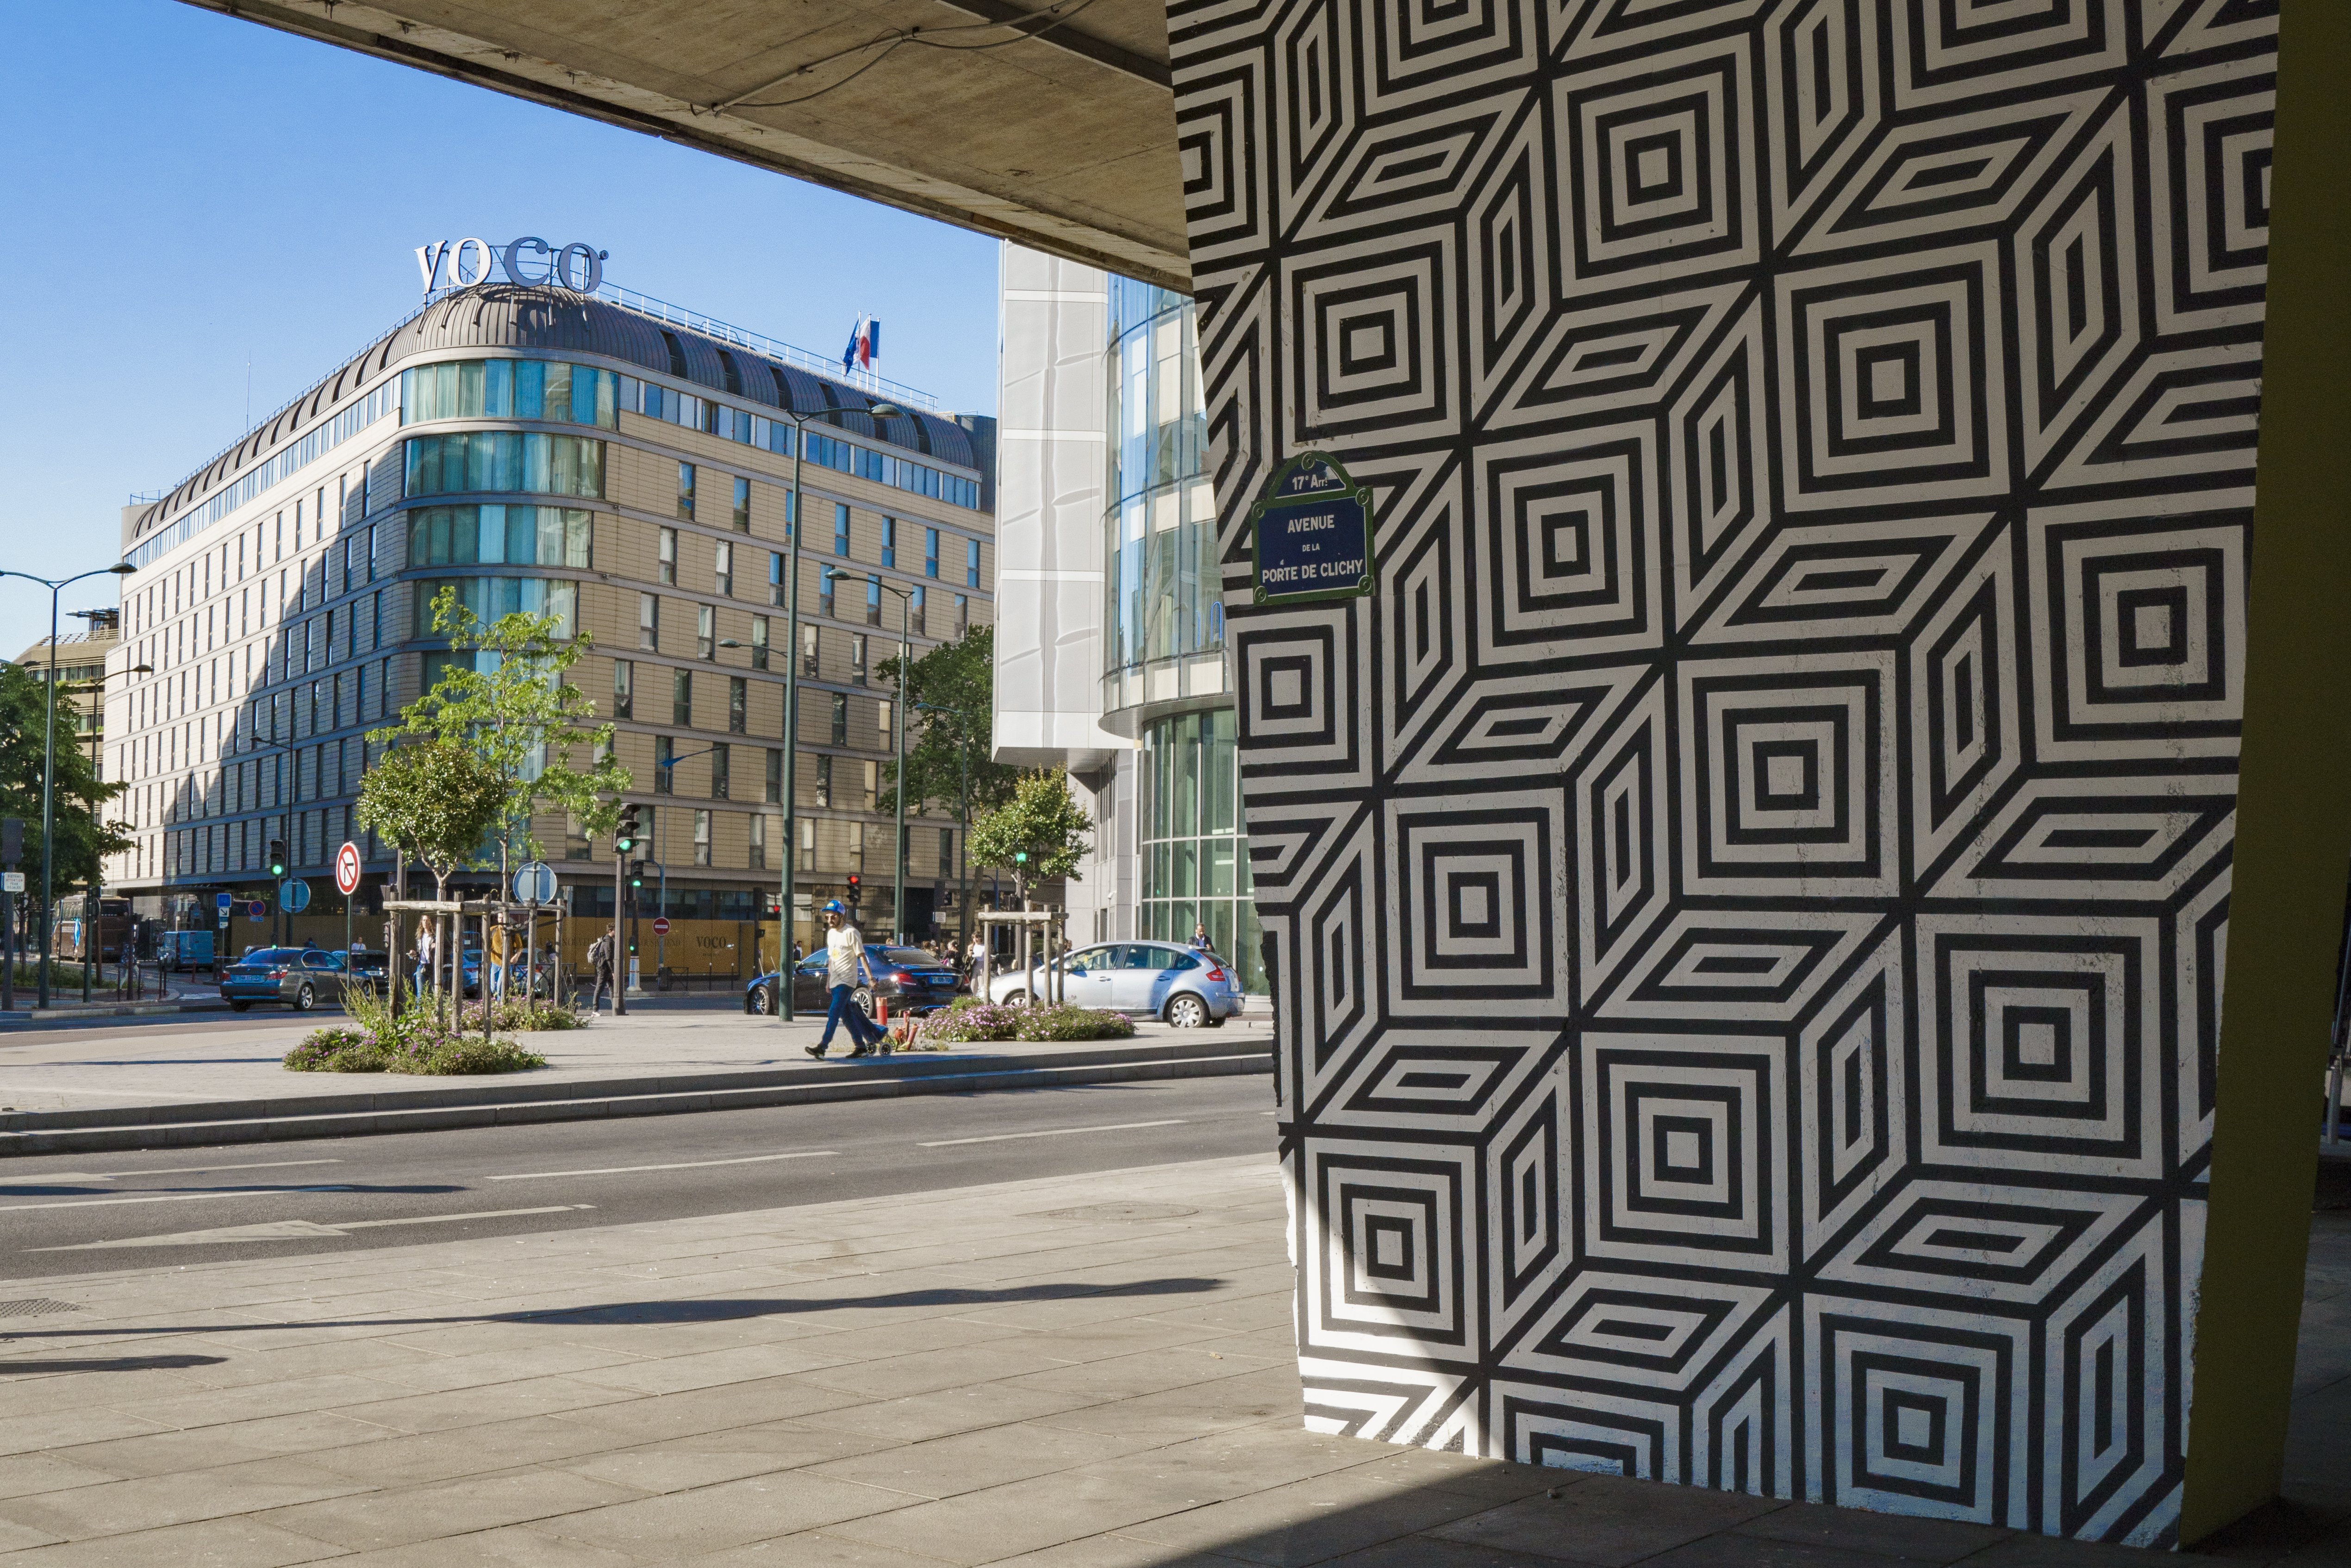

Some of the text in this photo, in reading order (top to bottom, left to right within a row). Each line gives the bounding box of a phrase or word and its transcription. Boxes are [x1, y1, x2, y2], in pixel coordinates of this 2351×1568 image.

[1288, 515, 1335, 533] AVENUE
[1262, 559, 1363, 583] PORTE DE CLICHY
